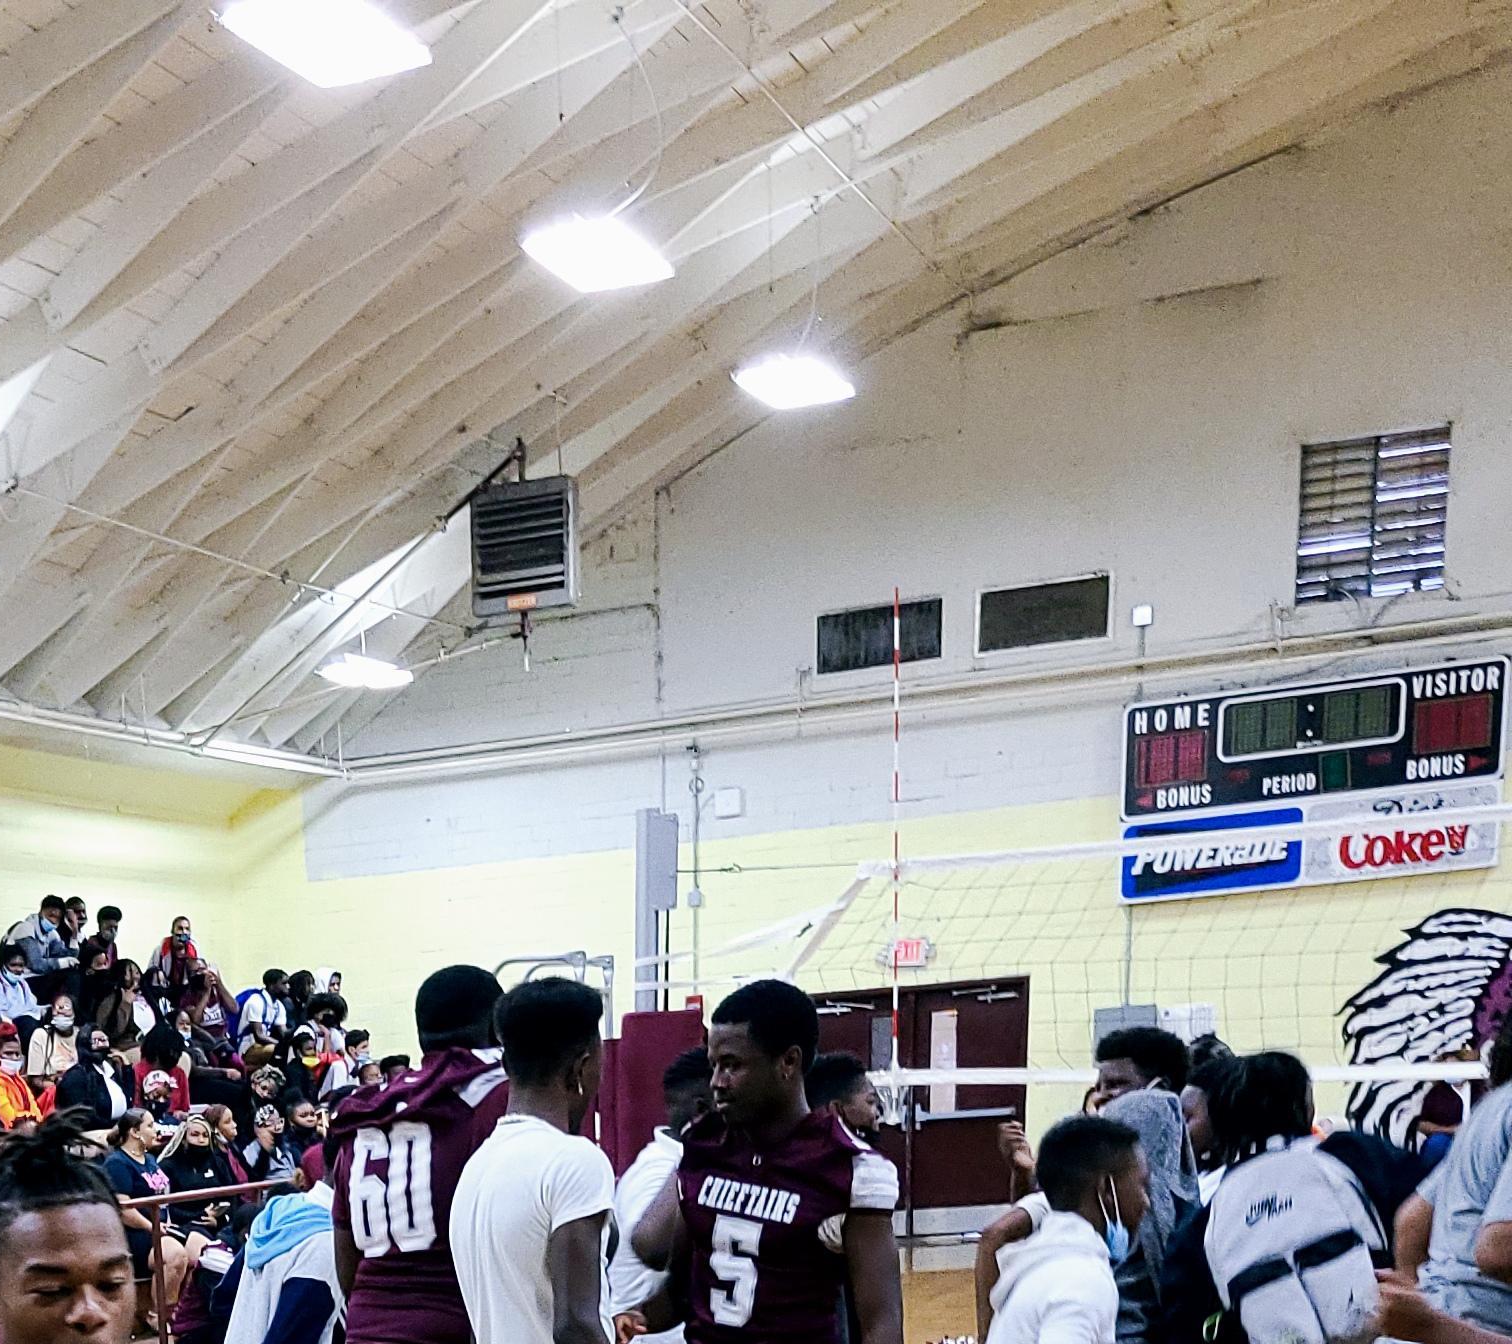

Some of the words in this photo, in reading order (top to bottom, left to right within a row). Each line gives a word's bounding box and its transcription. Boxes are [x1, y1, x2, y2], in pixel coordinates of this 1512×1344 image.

[1411, 665, 1500, 699] VISITOR
[1134, 703, 1211, 735] HOME
[1405, 753, 1466, 780] BONUS
[1156, 784, 1212, 809] BONUS
[1262, 772, 1317, 796] PERIOD
[1339, 826, 1446, 870] Coke
[348, 1121, 438, 1258] 60
[697, 1174, 801, 1225] CHIEFTAINS
[709, 1213, 764, 1328] 5
